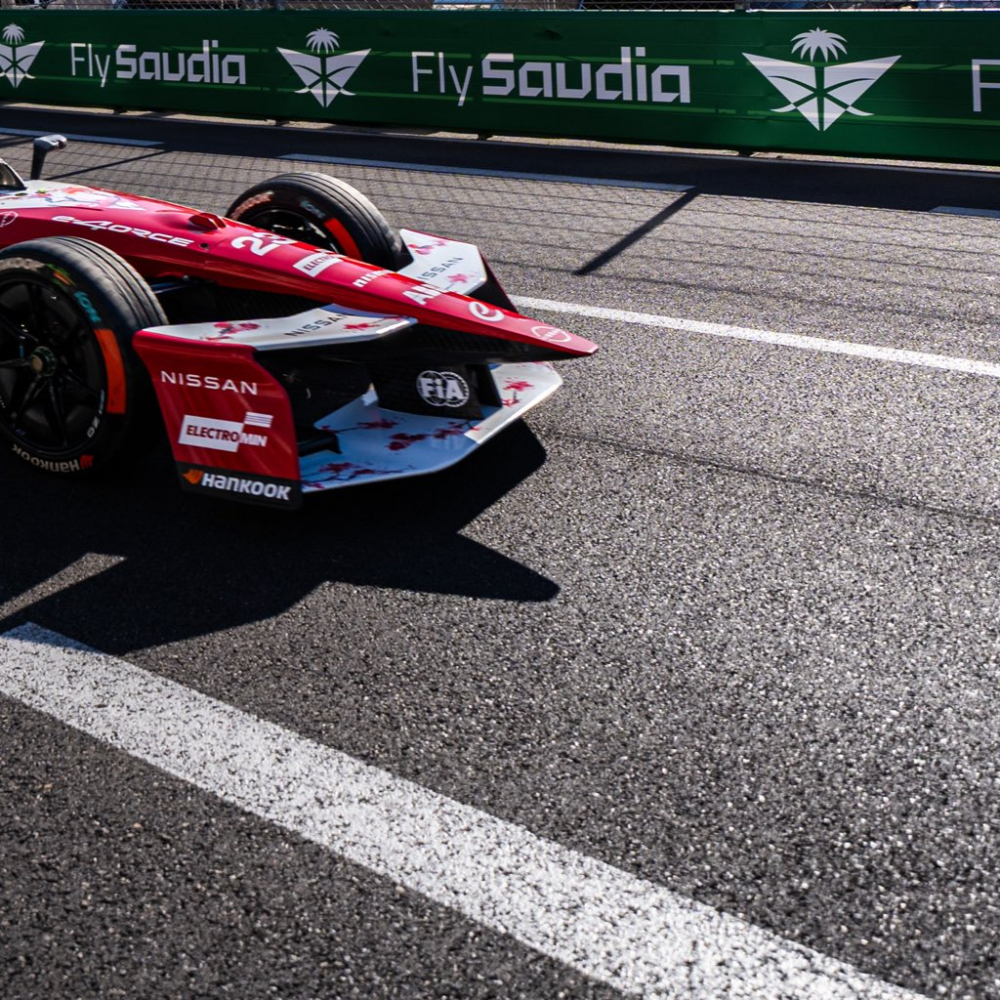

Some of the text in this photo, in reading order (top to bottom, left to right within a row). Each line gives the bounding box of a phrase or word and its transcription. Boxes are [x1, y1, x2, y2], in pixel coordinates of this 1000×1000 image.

[69, 38, 247, 87] FlySaudia
[411, 46, 692, 106] FlySaudia
[230, 232, 299, 256] 23
[417, 257, 463, 280] ISSAN
[283, 313, 346, 337] NISSA
[160, 370, 258, 396] NISSAN
[186, 424, 268, 448] ELECTROMIN
